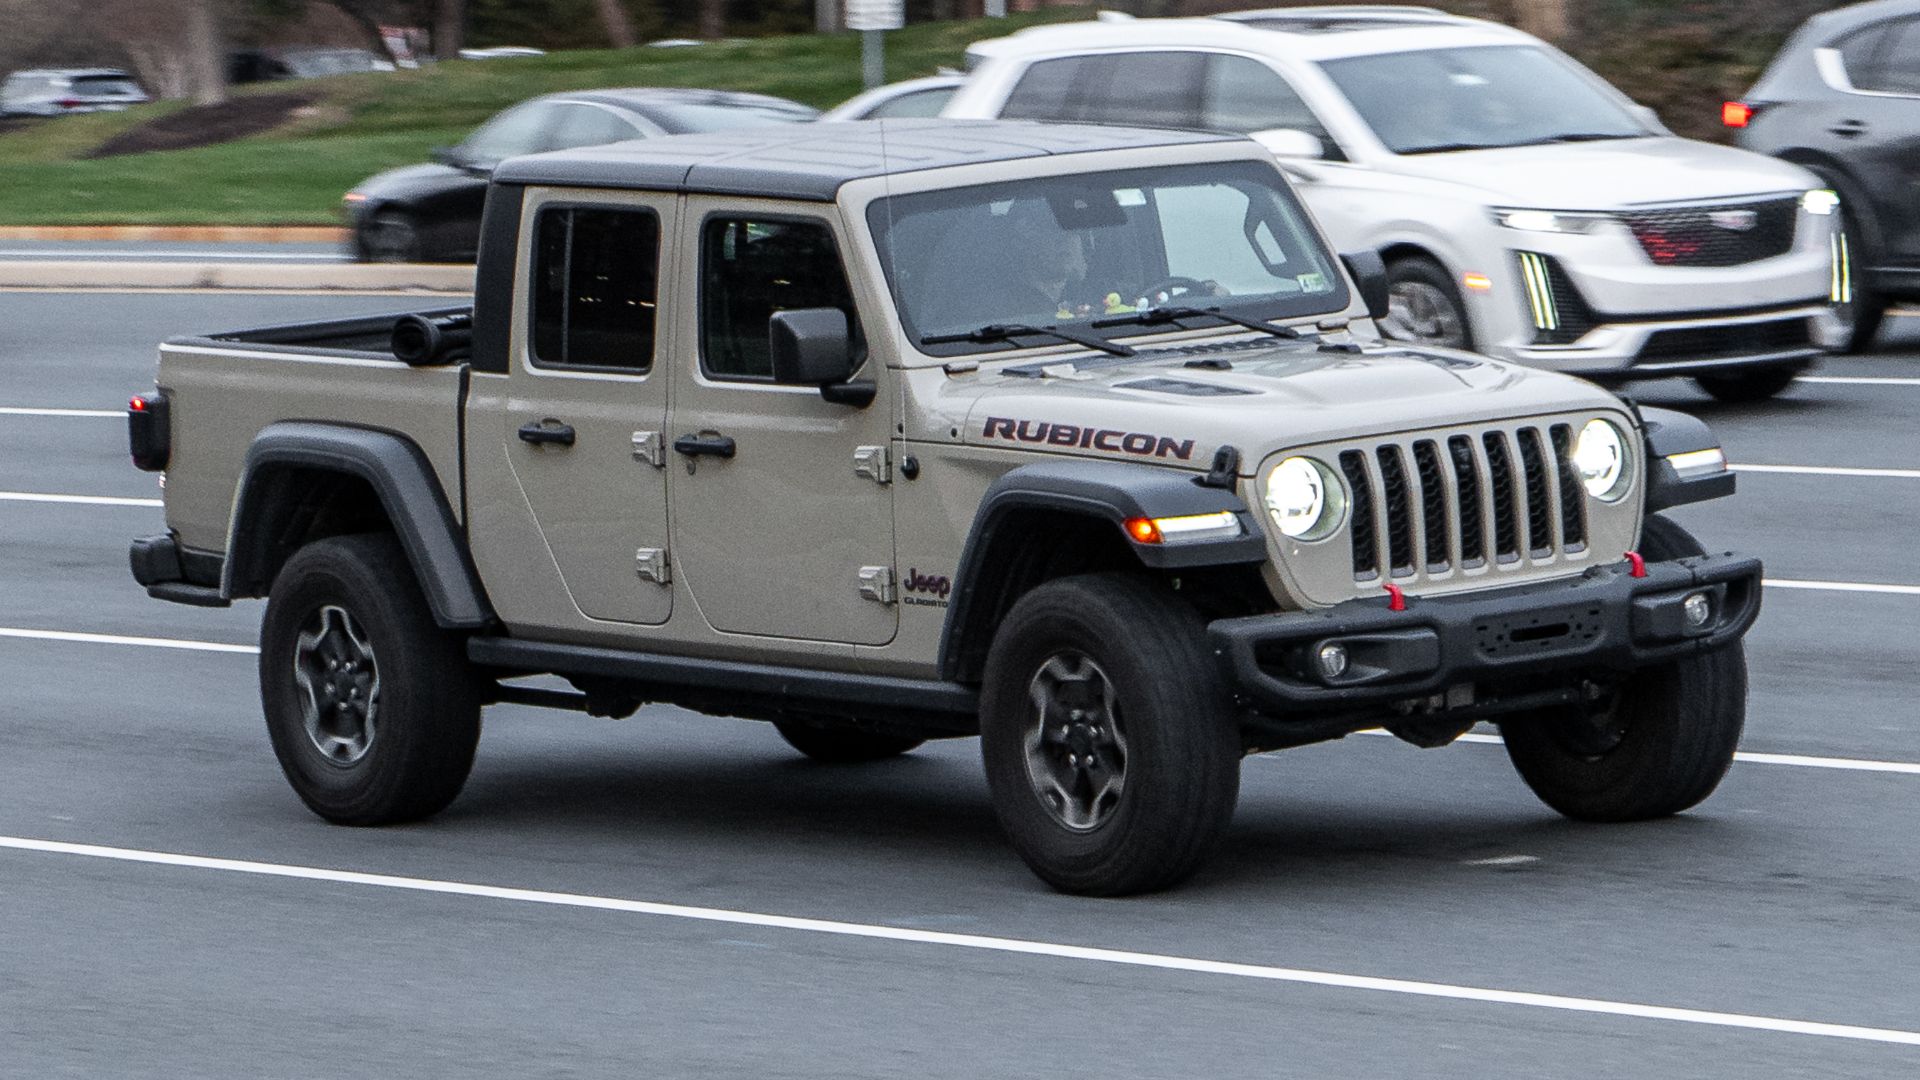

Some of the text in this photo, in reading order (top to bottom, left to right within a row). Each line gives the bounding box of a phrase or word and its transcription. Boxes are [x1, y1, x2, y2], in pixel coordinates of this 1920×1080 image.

[983, 416, 1195, 460] RUBICON
[903, 568, 951, 599] Jeep
[904, 597, 949, 608] GLADIATO
